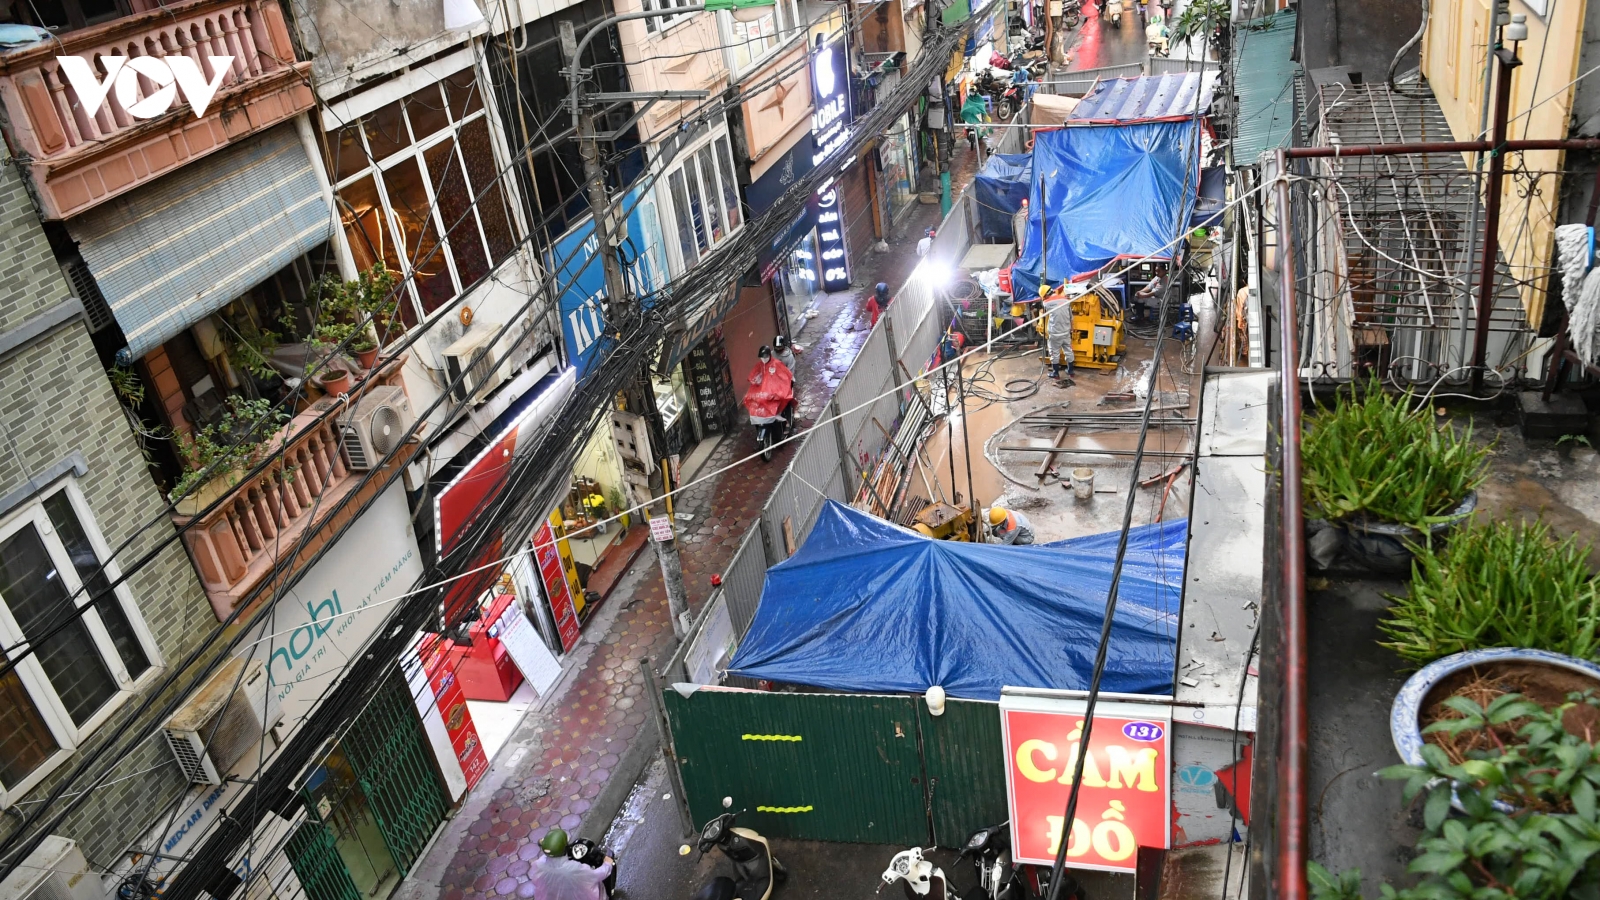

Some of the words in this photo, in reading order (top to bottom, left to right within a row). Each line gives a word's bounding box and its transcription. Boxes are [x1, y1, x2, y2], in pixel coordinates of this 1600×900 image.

[1016, 720, 1159, 792] CẦM
[1129, 725, 1160, 739] 131
[470, 758, 480, 772] 142
[163, 808, 203, 853] MEDCARE
[203, 782, 230, 812] DIRECT
[1046, 799, 1136, 862] ĐỒ
